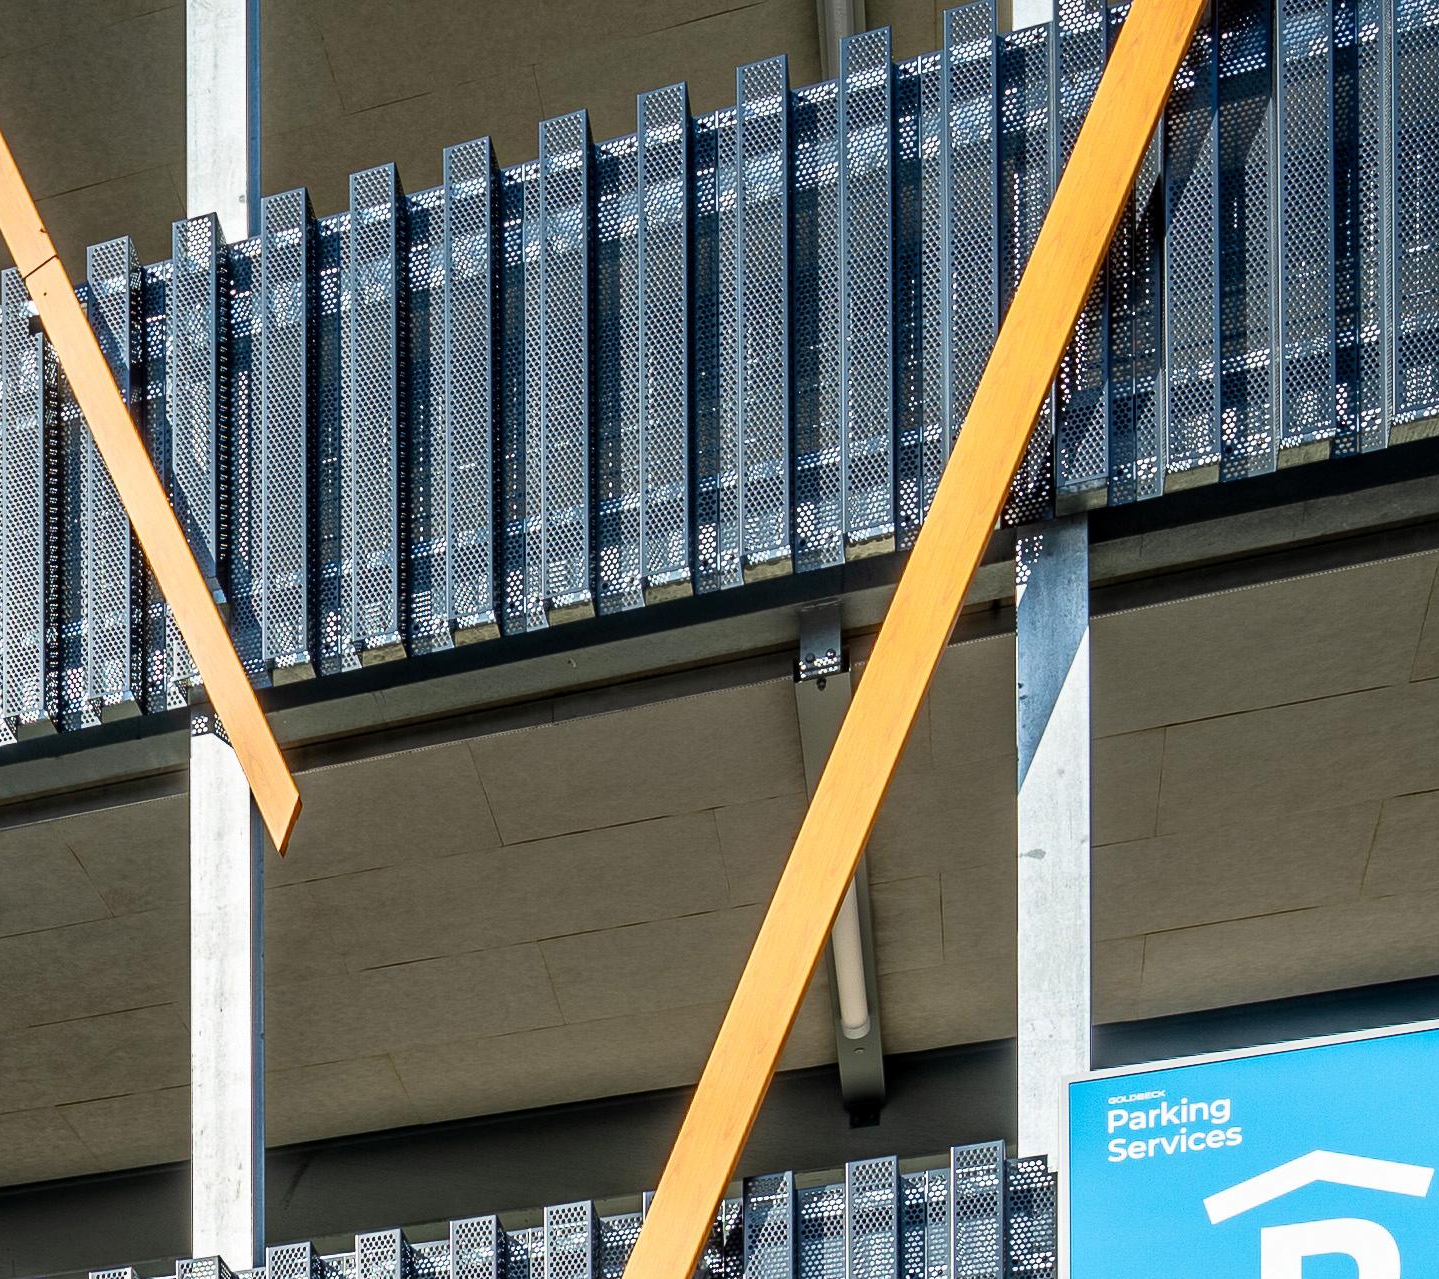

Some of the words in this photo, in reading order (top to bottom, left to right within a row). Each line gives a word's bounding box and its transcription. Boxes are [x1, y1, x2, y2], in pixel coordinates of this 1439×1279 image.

[1107, 1090, 1166, 1104] GOLDBECK
[1107, 1097, 1231, 1134] Parking
[1107, 1127, 1243, 1162] Services
